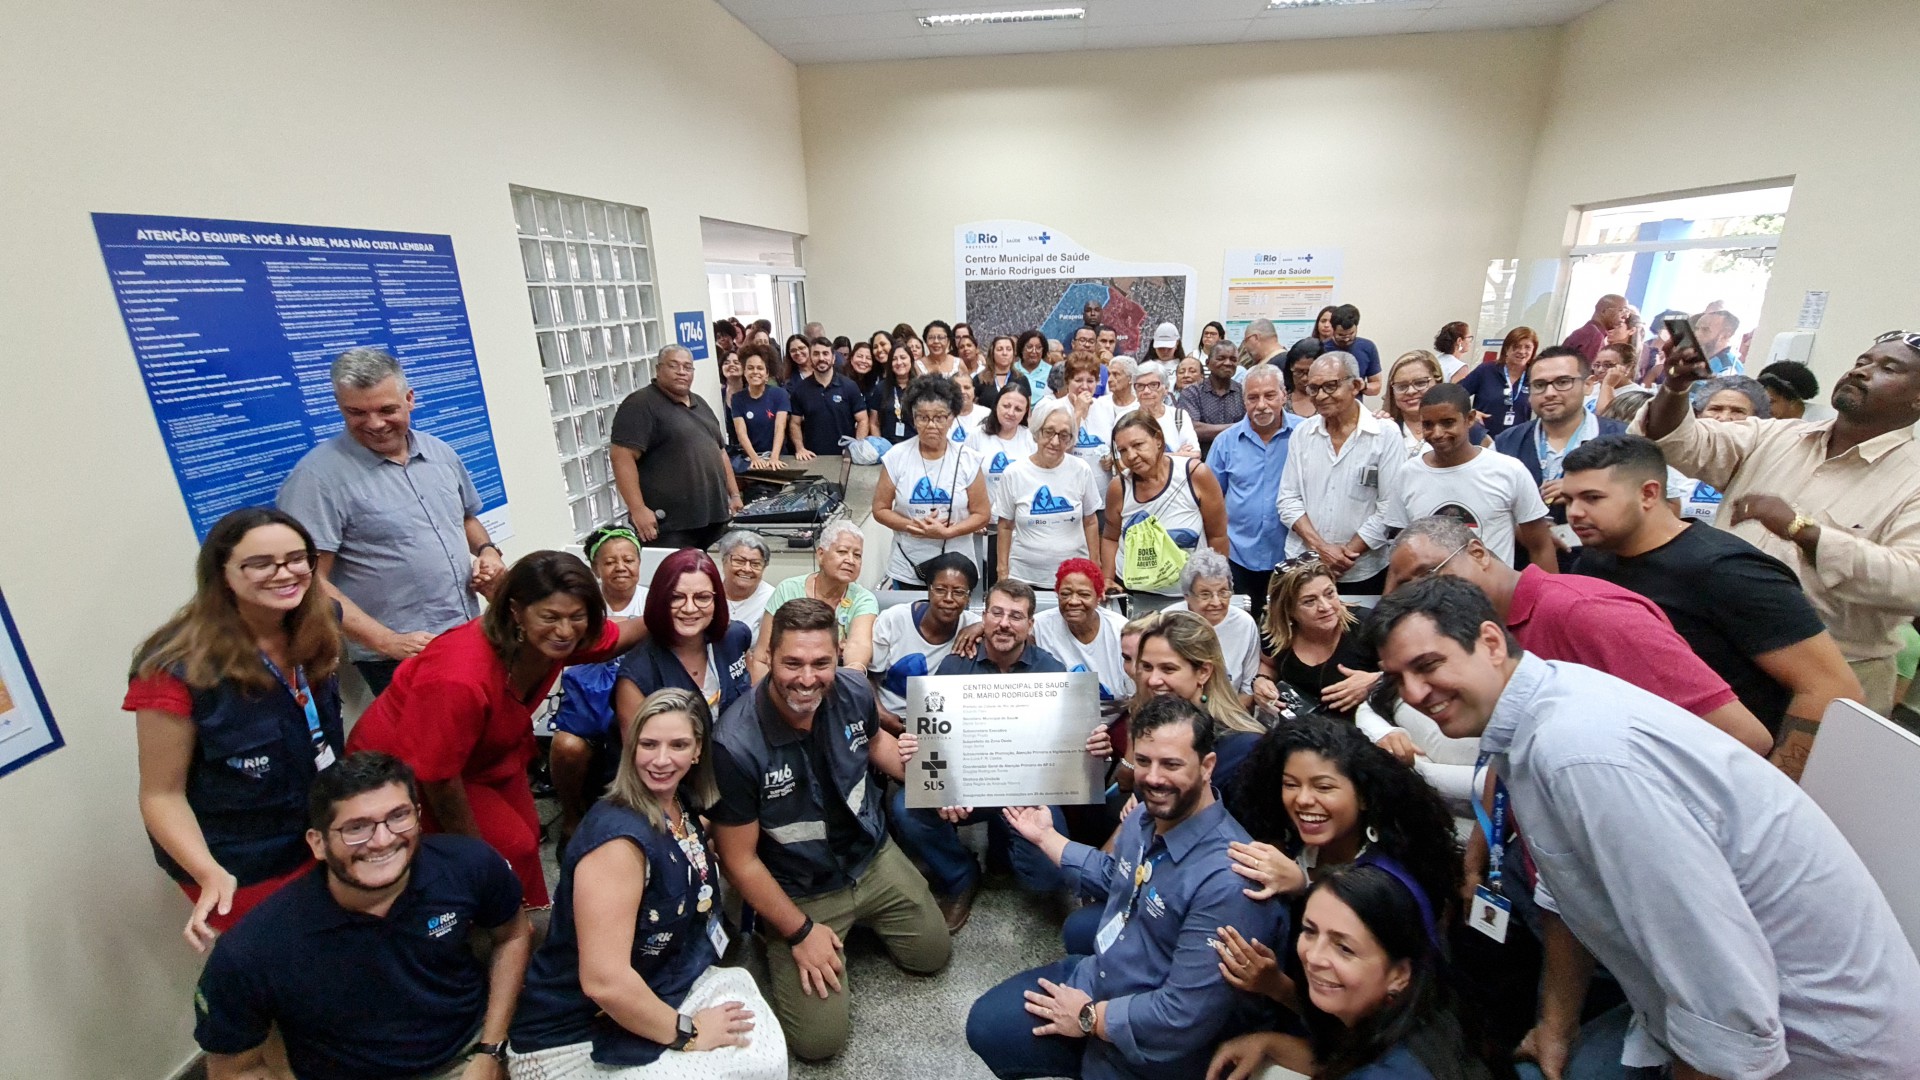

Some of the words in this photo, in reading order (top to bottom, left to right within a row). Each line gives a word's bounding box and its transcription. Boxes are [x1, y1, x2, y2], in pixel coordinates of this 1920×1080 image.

[137, 228, 200, 242] ATENÇÃO
[201, 232, 252, 244] EQUIPE:
[252, 233, 284, 245] VOCÊ
[285, 234, 298, 246] JÁ
[299, 236, 330, 248] SABE,
[328, 238, 350, 248] MAS
[351, 238, 371, 248] NÃO
[372, 240, 398, 250] CUSTA
[400, 242, 434, 252] LEMBRAR
[978, 234, 998, 244] Rio
[965, 254, 996, 264] Centro
[999, 254, 1044, 264] Municipal
[1046, 253, 1058, 262] de
[1060, 252, 1090, 262] Saúde
[965, 267, 978, 276] Dr.
[980, 266, 1006, 276] Mário
[1009, 266, 1056, 276] Rodrigues
[1060, 265, 1075, 274] Cid
[680, 320, 703, 342] 1746
[917, 717, 952, 734] Rio
[765, 764, 792, 785] 1746
[924, 781, 944, 790] SUS
[440, 912, 456, 924] Rio
